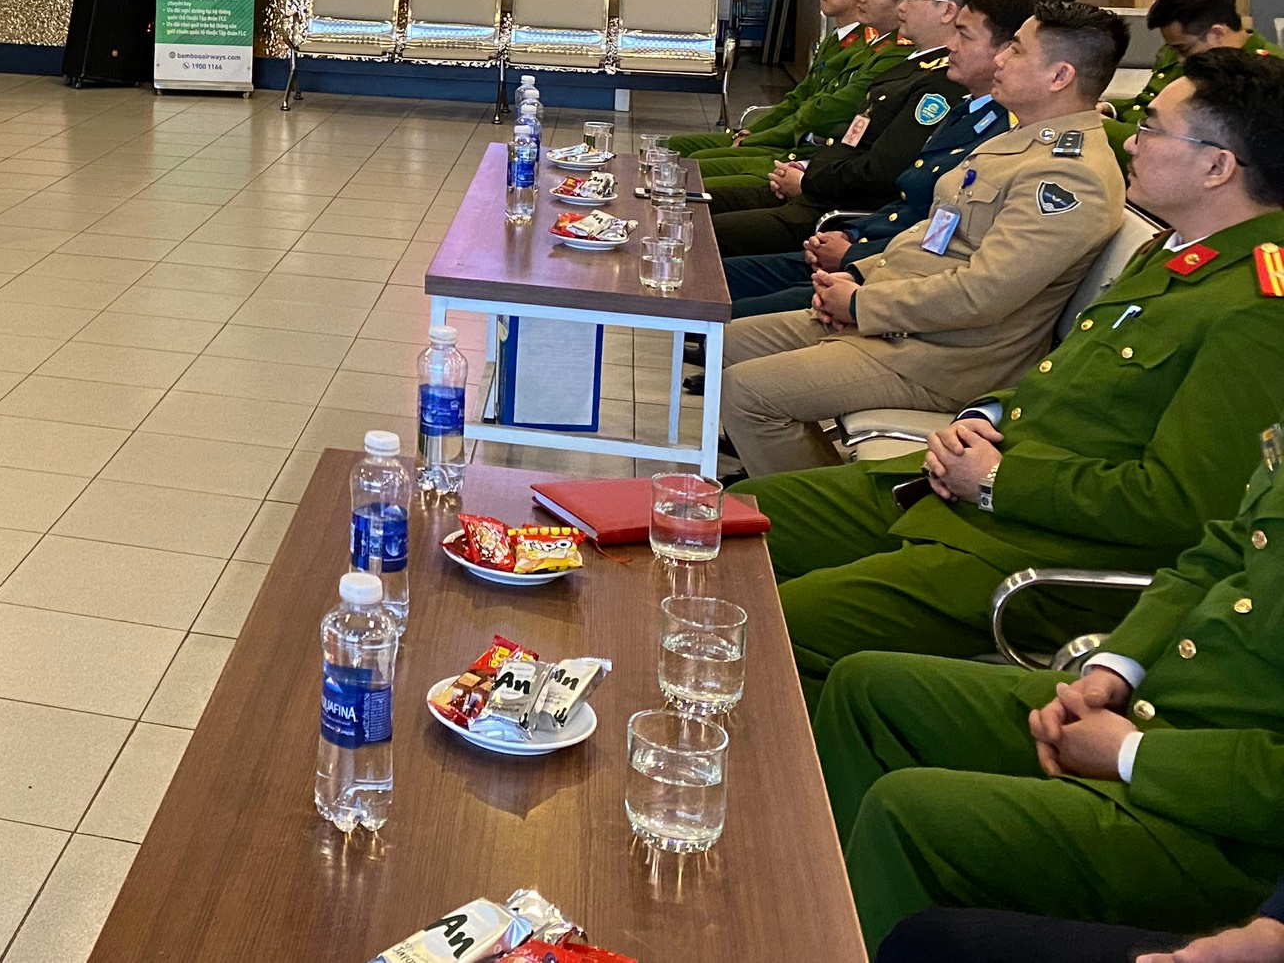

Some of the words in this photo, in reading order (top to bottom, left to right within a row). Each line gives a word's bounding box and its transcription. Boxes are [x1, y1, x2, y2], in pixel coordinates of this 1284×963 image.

[177, 53, 241, 61] bambooairways.com
[492, 671, 531, 695] An
[425, 913, 475, 960] An
